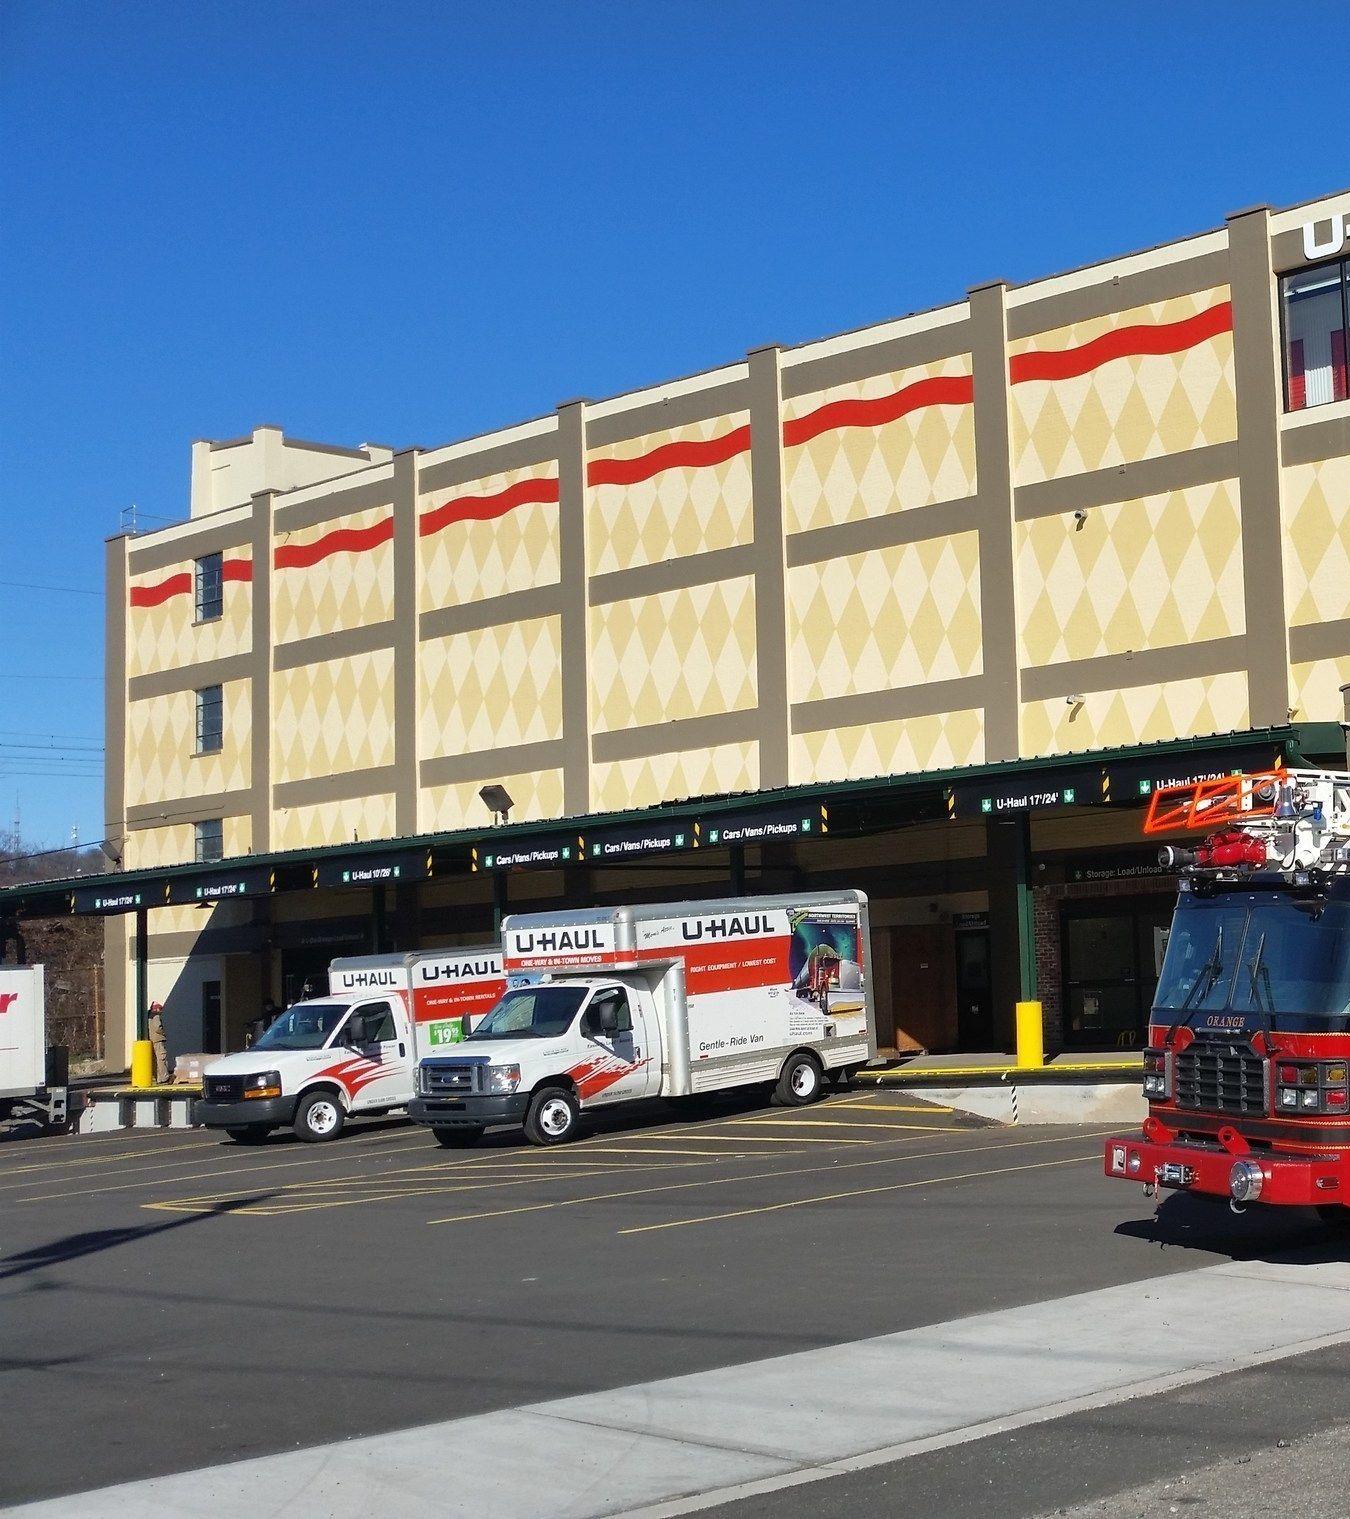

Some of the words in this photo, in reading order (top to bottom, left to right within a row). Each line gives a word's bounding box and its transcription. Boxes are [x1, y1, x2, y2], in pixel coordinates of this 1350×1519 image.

[1156, 777, 1190, 790] U-Haul
[996, 796, 1028, 809] U-Haul
[1029, 792, 1059, 805] 17'/24'
[352, 870, 372, 880] U-Haul
[682, 915, 775, 940] U-HAUL
[515, 929, 605, 953] U-HAUL
[422, 960, 501, 981] U-HAUL
[342, 971, 397, 988] U-HAUL
[1206, 1015, 1245, 1027] ORANGE
[749, 1034, 764, 1043] Van
